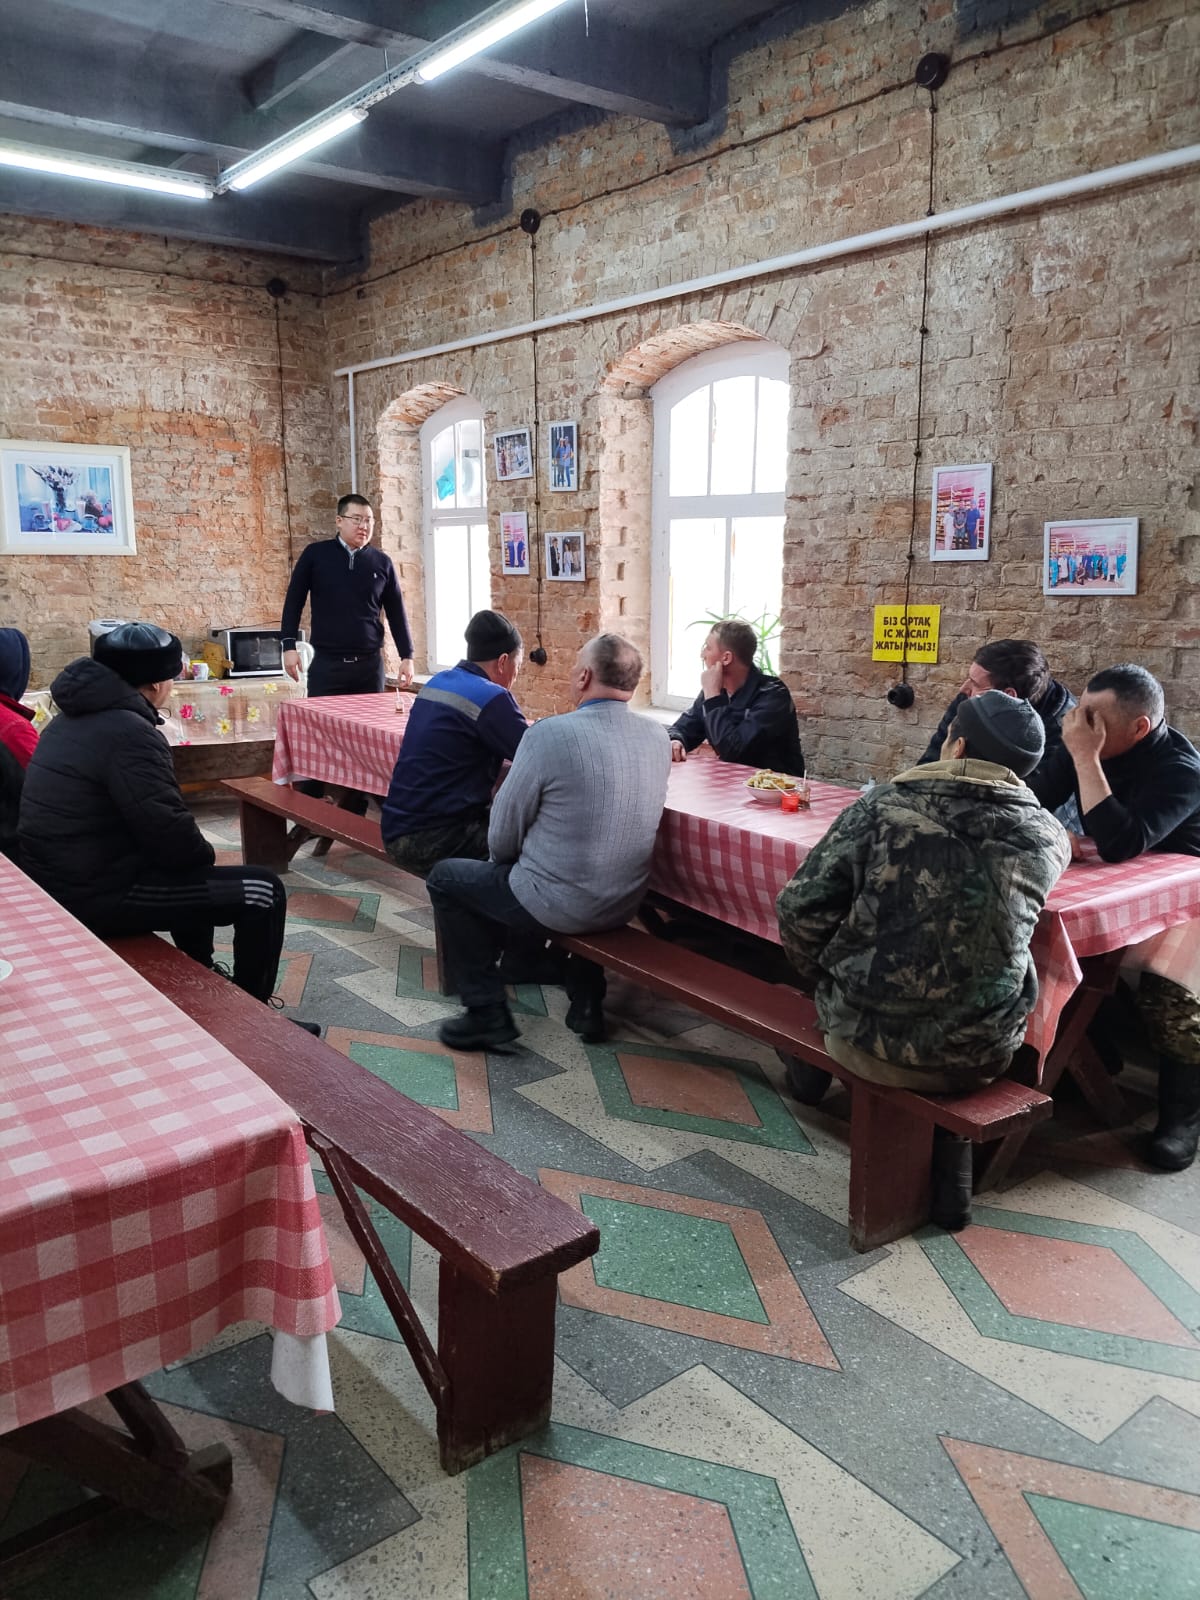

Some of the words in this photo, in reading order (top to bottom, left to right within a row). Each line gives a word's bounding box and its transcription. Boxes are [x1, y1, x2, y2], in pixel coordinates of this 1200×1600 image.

[883, 617, 898, 626] БІЗ
[900, 617, 931, 628] ОРТАҚ
[884, 629, 893, 638] ІС
[875, 641, 936, 652] ЖАТЫРМЫЗ!
